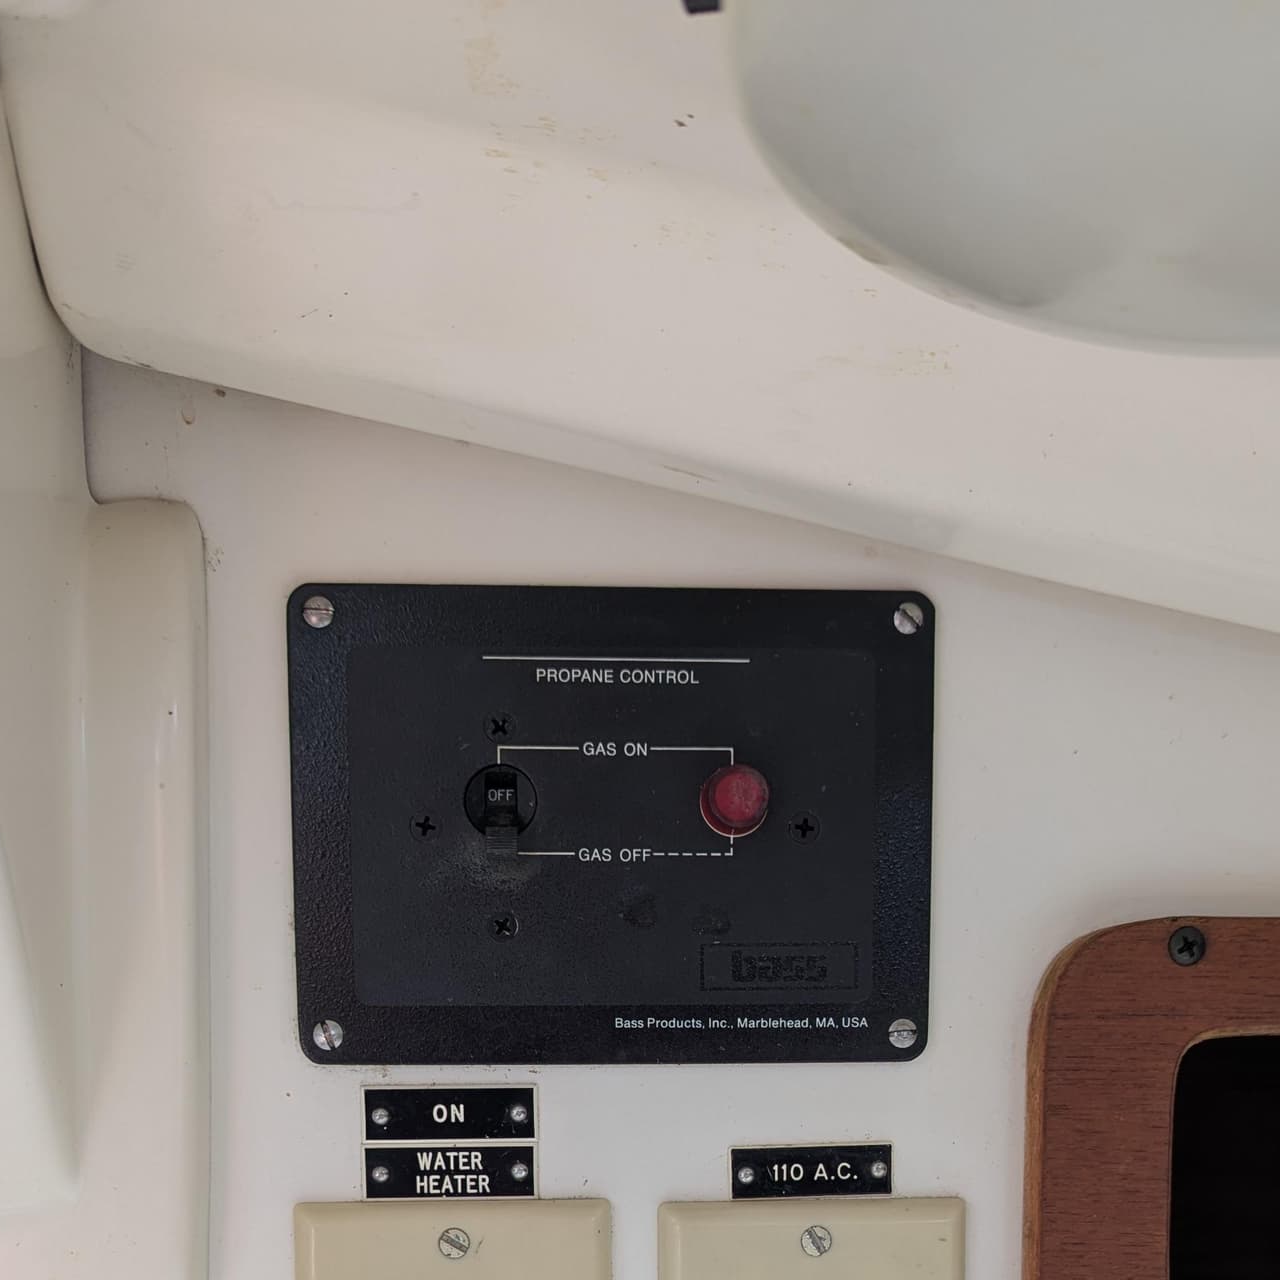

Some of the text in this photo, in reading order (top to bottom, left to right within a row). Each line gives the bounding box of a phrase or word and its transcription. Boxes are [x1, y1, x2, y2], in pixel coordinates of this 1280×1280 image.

[535, 668, 701, 685] PROPANE CONTROL
[582, 741, 649, 758] GAS ON
[487, 788, 514, 802] OFF
[578, 847, 652, 864] GAS OFF
[614, 1016, 870, 1031] Bass Products, Inc., Marblehead, MA, USA
[431, 1103, 466, 1124] ON
[416, 1151, 484, 1171] WATER
[771, 1162, 859, 1183] 110 A.C.
[415, 1174, 491, 1195] HEATER
